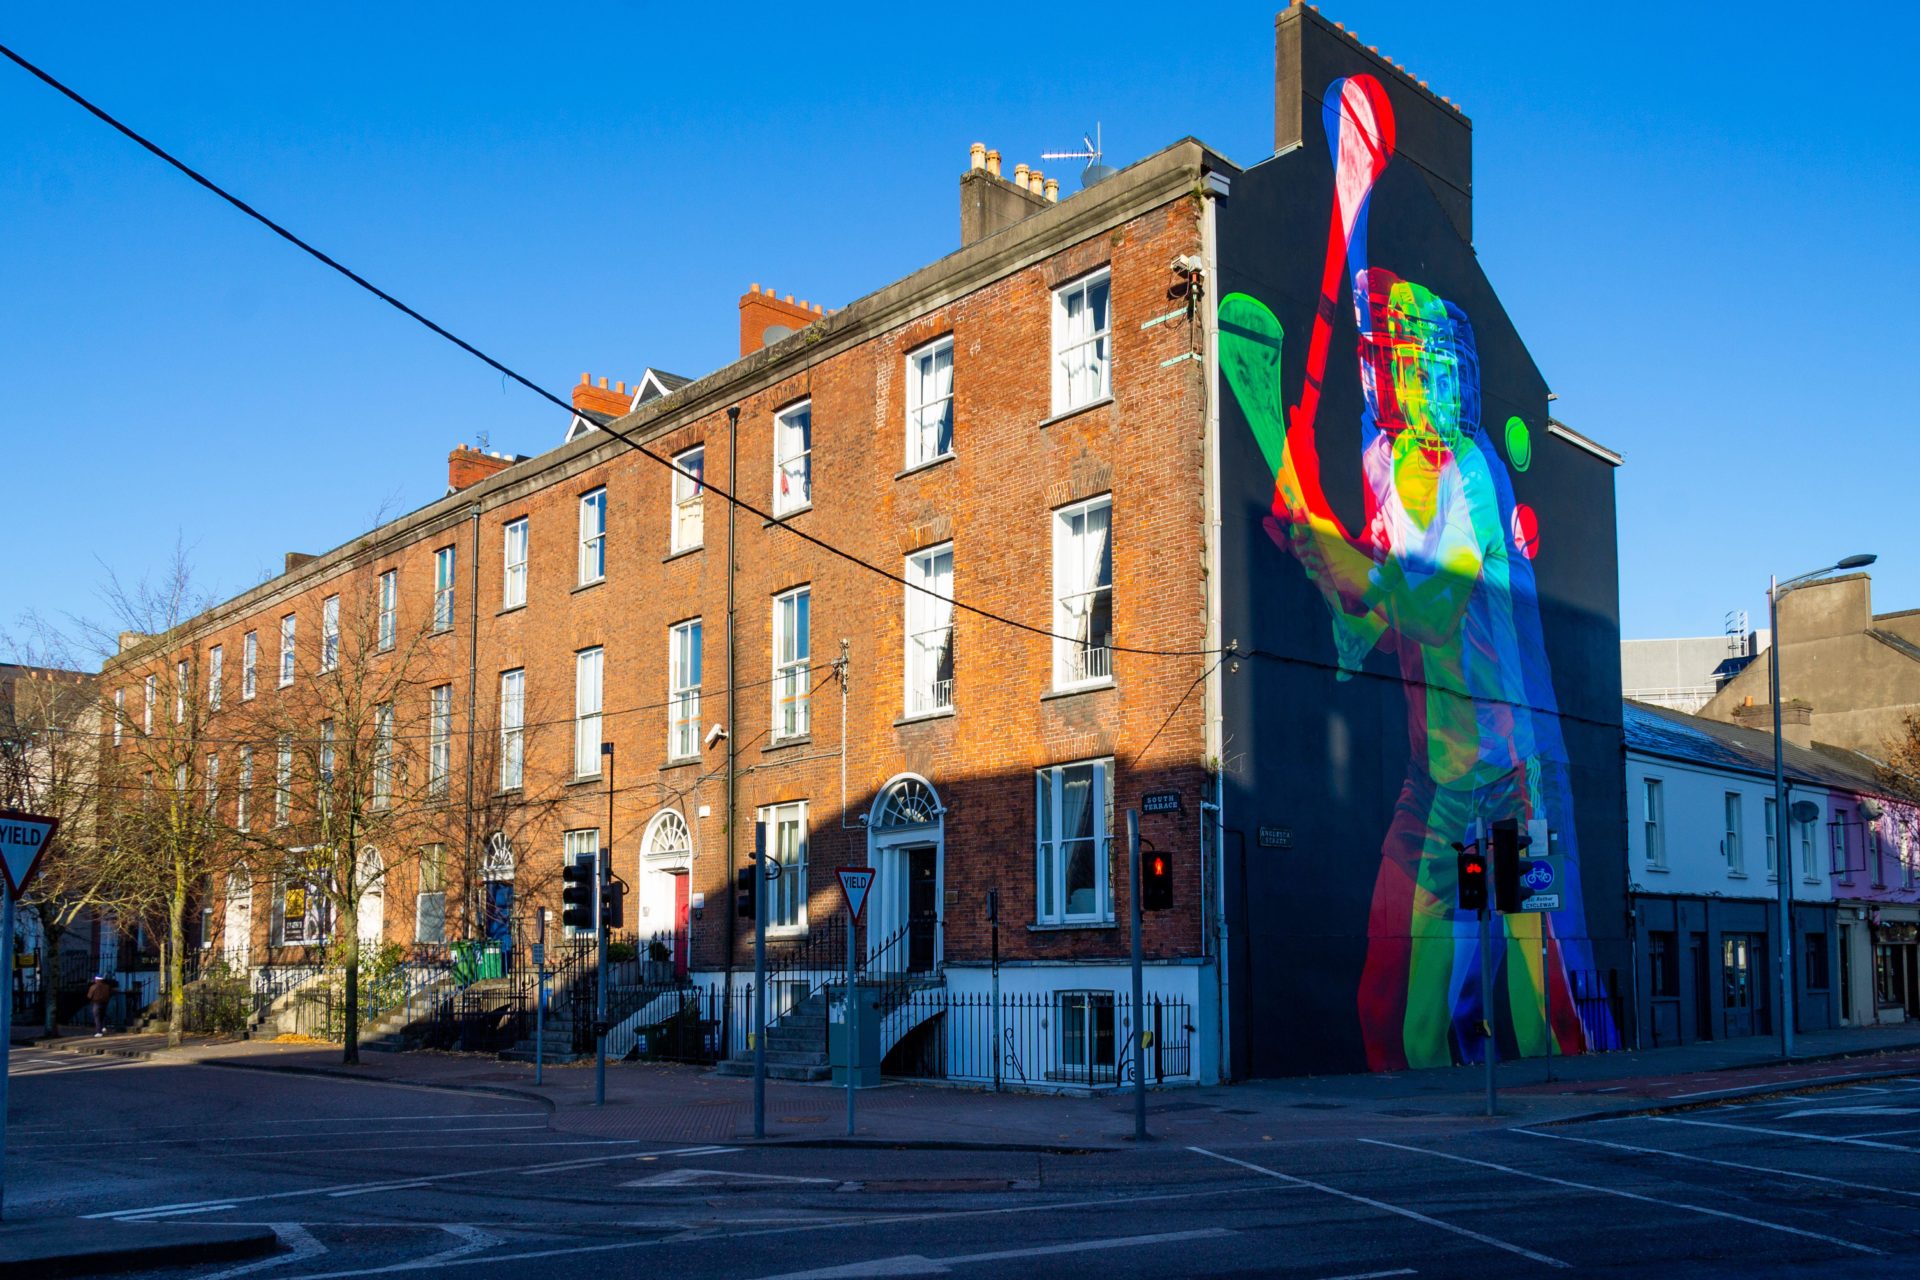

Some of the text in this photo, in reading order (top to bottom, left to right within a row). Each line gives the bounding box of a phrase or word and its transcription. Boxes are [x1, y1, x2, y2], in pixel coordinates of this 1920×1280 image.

[1147, 795, 1174, 803] SOUTH
[1144, 802, 1177, 810] TERRACE
[0, 824, 41, 846] YIELD
[843, 876, 867, 888] YIELD
